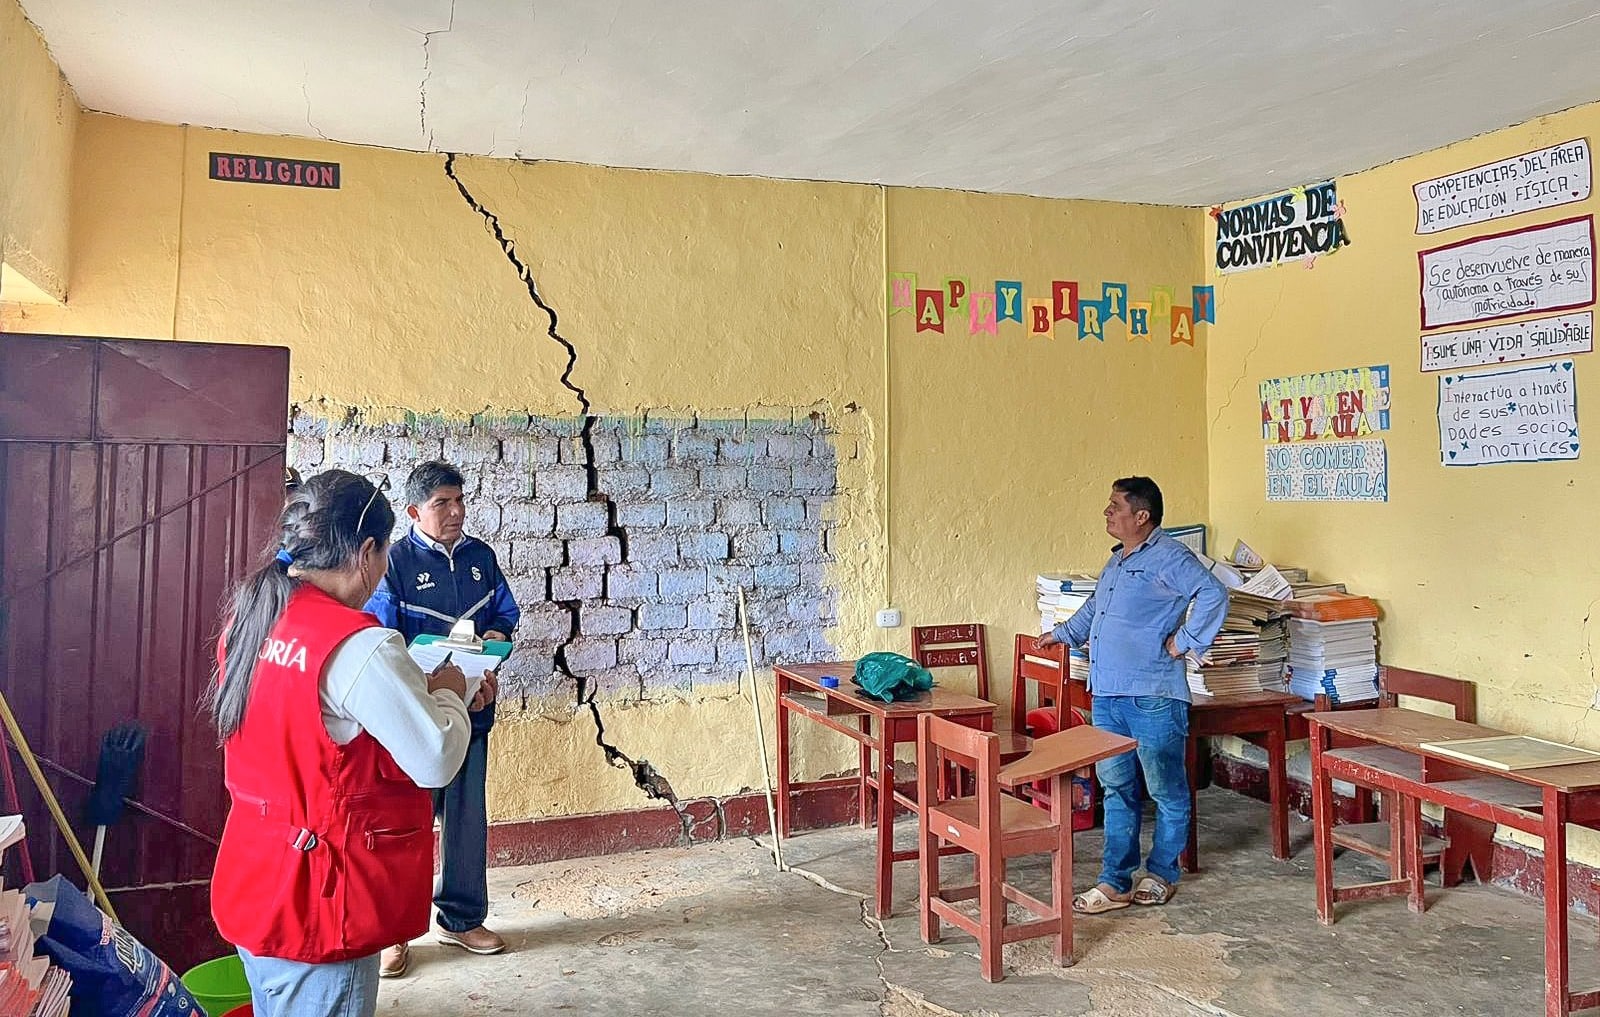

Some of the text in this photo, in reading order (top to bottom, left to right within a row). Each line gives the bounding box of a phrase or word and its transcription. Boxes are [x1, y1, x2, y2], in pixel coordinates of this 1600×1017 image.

[216, 156, 334, 187] RELIGION
[1418, 164, 1518, 202] COMPETENCIAS
[1550, 145, 1584, 168] ÁREA
[1216, 182, 1336, 241] NORMAS DE
[1423, 208, 1435, 226] DE
[1515, 176, 1568, 202] FÍSICA
[1216, 218, 1351, 269] CONVIVENCIA
[1429, 246, 1591, 286] Se desenvuelve de manera
[1442, 268, 1580, 300] autónoma a través de su
[891, 278, 1211, 341] HAPPY BIRTHDAY
[1462, 338, 1482, 356] UNA
[1489, 333, 1523, 351] VIDA
[1530, 325, 1590, 347] SALUDABLE
[1445, 378, 1567, 403] Interactúa a través
[1268, 411, 1374, 444] EN EL AULA
[1453, 406, 1470, 422] de
[1479, 407, 1509, 419] sus
[1517, 419, 1569, 436] socio
[1267, 445, 1366, 471] NO COMER
[1268, 473, 1388, 497] EN EL AULA
